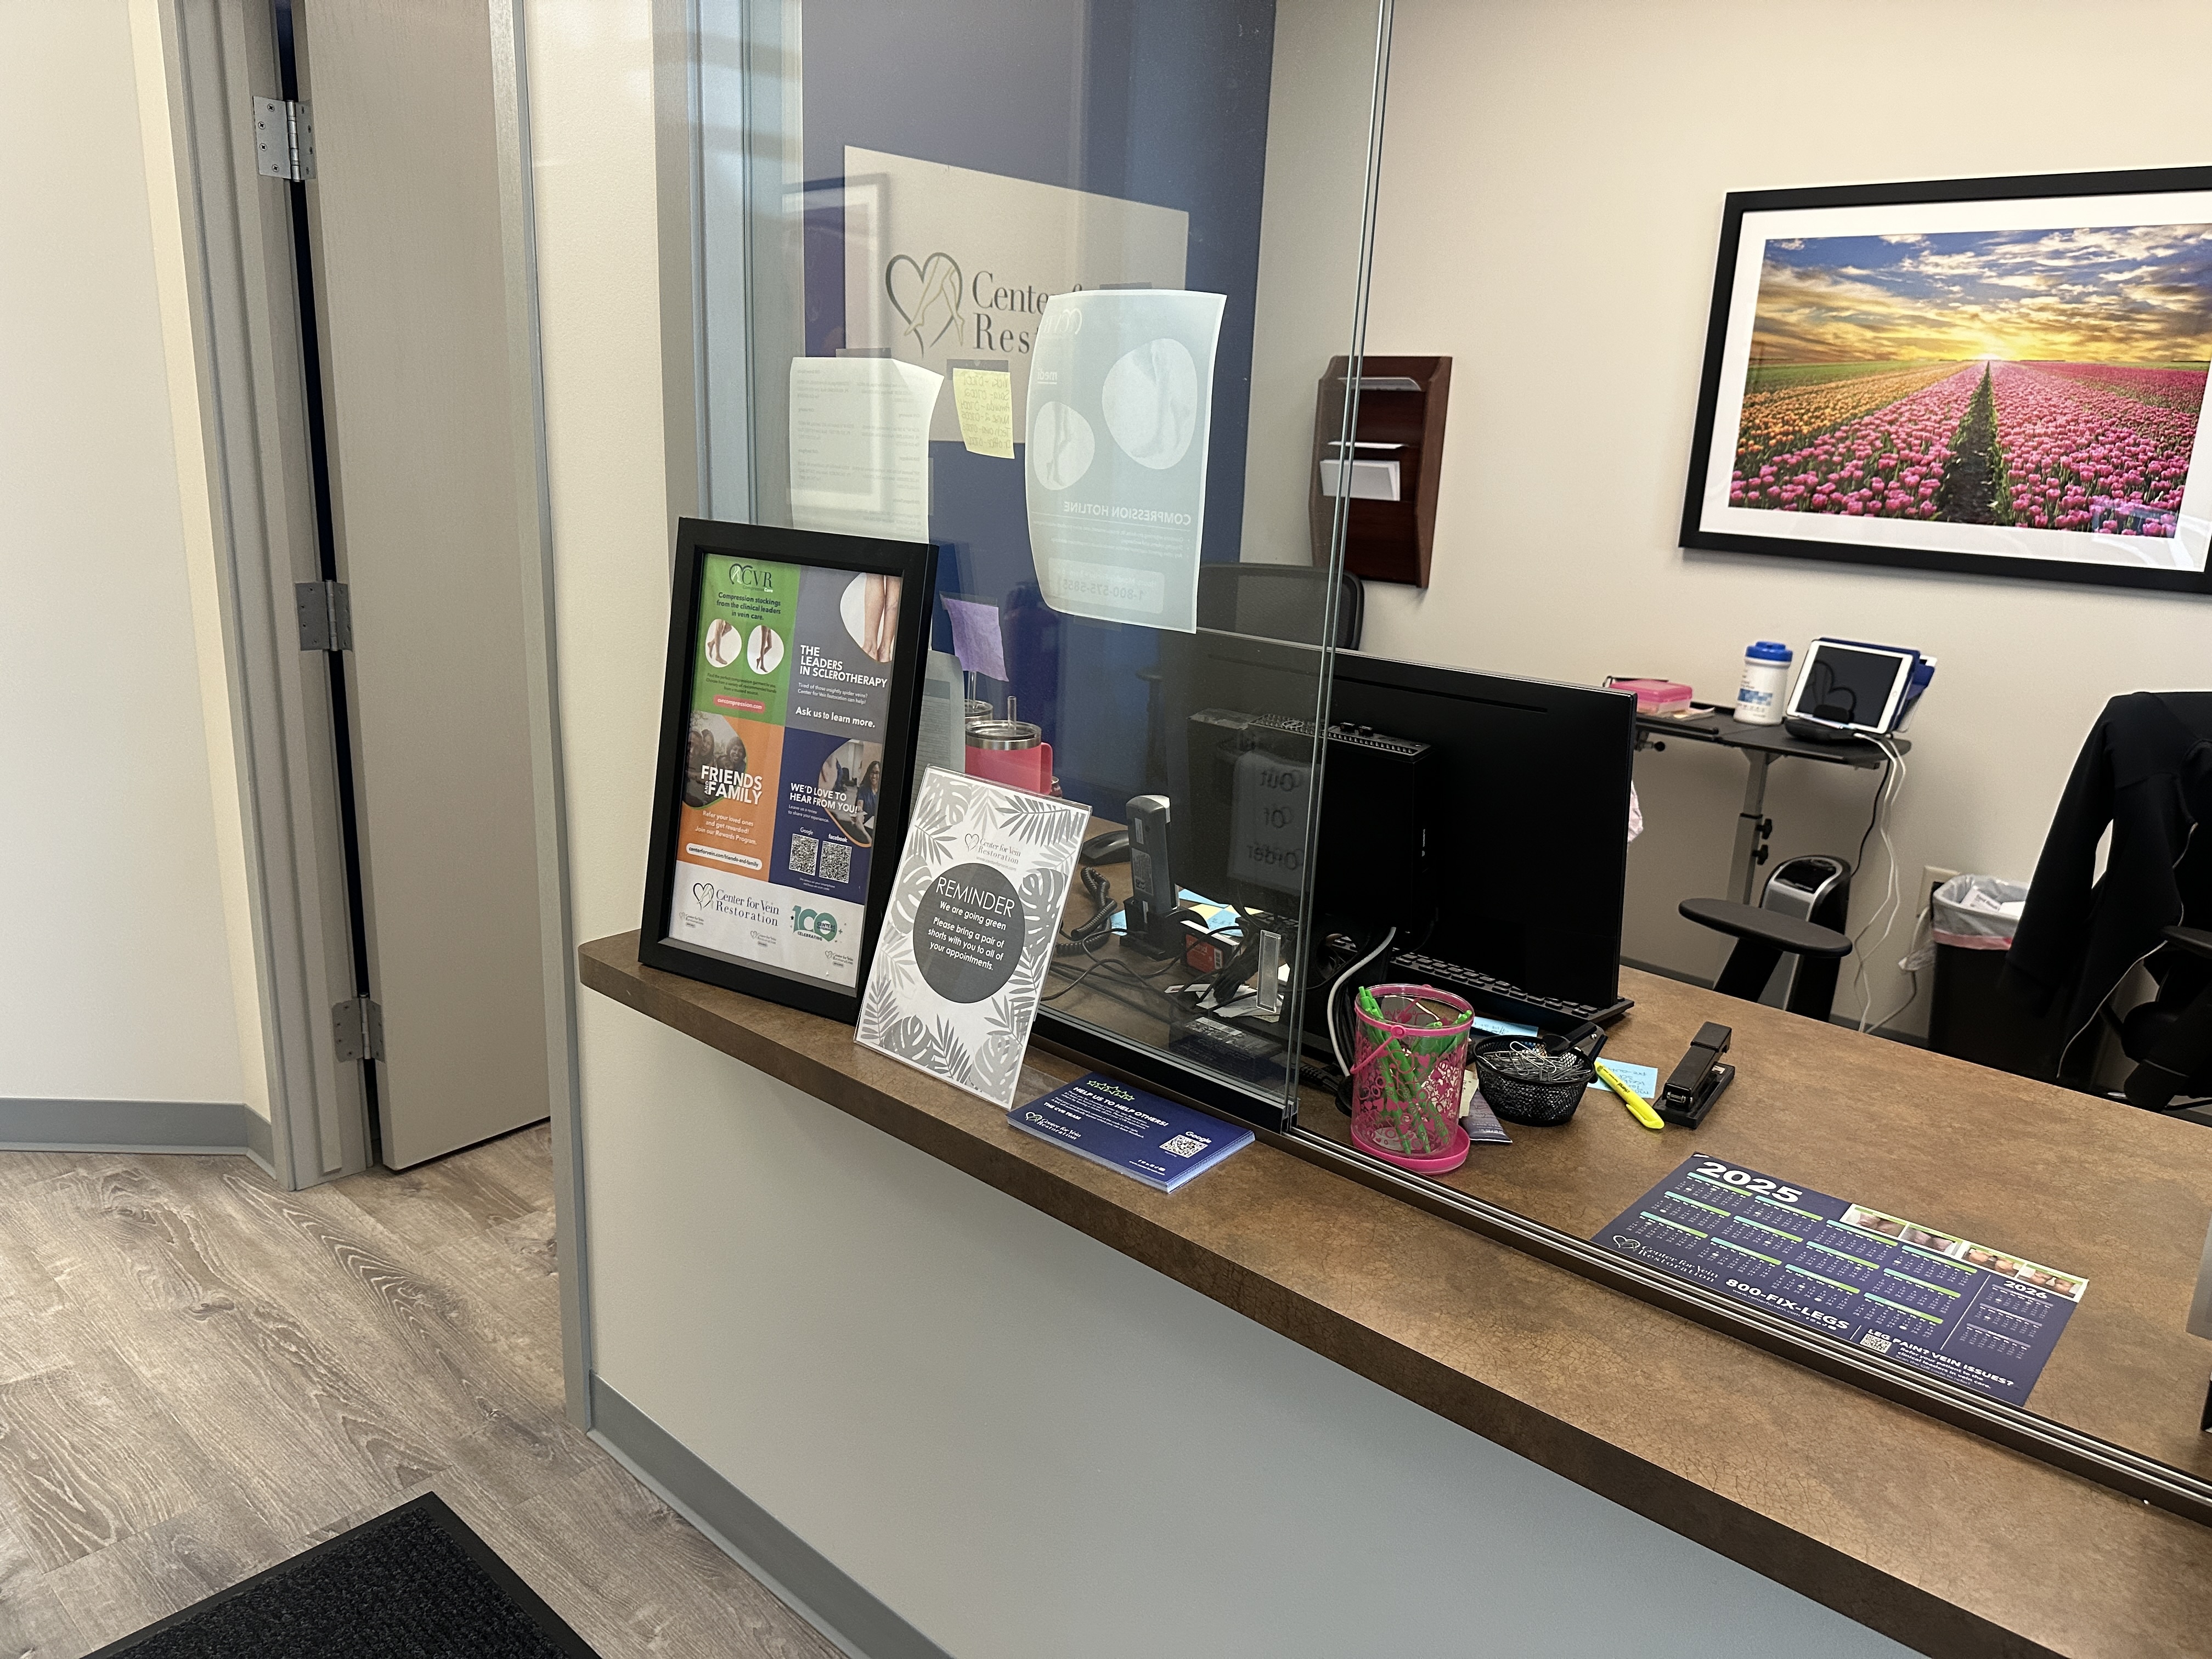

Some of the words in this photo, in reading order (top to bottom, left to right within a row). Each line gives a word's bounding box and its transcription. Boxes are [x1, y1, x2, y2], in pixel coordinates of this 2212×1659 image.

[972, 270, 1057, 315] Cente
[973, 313, 1039, 354] Res
[742, 569, 773, 588] CVR
[718, 592, 754, 602] Compression
[755, 597, 781, 607] stockings
[740, 602, 760, 612] clinical
[761, 606, 781, 614] leaders
[800, 645, 820, 657] THE
[800, 656, 843, 671] LEADERS
[799, 665, 810, 676] IN
[812, 668, 888, 688] SCLEROTHERAPY
[795, 706, 811, 716] Ask
[823, 711, 830, 720] to
[831, 712, 850, 724] learn
[852, 718, 876, 728] more.
[701, 765, 763, 791] FRIENDS
[708, 781, 763, 805] FAMILY
[789, 792, 811, 804] HEAR
[812, 797, 836, 810] FROM
[838, 802, 859, 814] YOU!
[791, 782, 812, 794] WE'D
[814, 787, 833, 799] LOVE
[835, 792, 847, 802] TO
[703, 810, 715, 819] Refer
[729, 815, 741, 825] loved
[725, 824, 749, 834] rewarded!
[715, 830, 735, 840] Rewards
[735, 836, 757, 845] Program.
[800, 827, 814, 836] Google
[828, 833, 848, 843] facebook
[978, 845, 1019, 865] Restoration
[980, 838, 999, 850] Center
[999, 844, 1008, 853] for
[1009, 846, 1021, 856] Vein
[716, 889, 745, 906] Center
[746, 896, 760, 910] for
[760, 900, 780, 915] Vein
[935, 876, 1015, 918] REMINDER
[715, 900, 779, 927] Restoration
[792, 905, 838, 942] 100
[940, 900, 950, 911] We
[951, 906, 963, 916] are
[964, 909, 985, 924] going
[985, 918, 1007, 930] green
[797, 930, 823, 941] CELEBRATING
[933, 916, 955, 931] Please
[956, 923, 973, 940] bring
[980, 934, 995, 945] pair
[996, 939, 1005, 949] of
[928, 928, 947, 941] shorts
[947, 934, 962, 946] with
[962, 940, 976, 951] you
[977, 945, 984, 954] to
[985, 947, 995, 957] all
[996, 952, 1004, 961] of
[929, 941, 945, 952] your
[945, 946, 994, 971] appointments.
[1065, 1111, 1082, 1120] TEAM
[1073, 1086, 1093, 1096] HELP
[1114, 1104, 1136, 1113] HELP
[1134, 1111, 1169, 1127] OTHERS!
[1037, 1120, 1077, 1140] Restoration
[1041, 1118, 1060, 1128] Center
[1185, 1131, 1212, 1144] Google
[1696, 1161, 1803, 1204] 2025
[1638, 1249, 1714, 1282] Restoration
[1642, 1246, 1678, 1261] Center
[1679, 1260, 1695, 1268] for
[1697, 1265, 1718, 1278] Vein
[2003, 1280, 2047, 1299] 2026
[1725, 1279, 1850, 1330] 800-FIX-LEGS
[1732, 1289, 1801, 1317] www.centerforvein.com
[1867, 1328, 1891, 1340] LEG
[1892, 1338, 1930, 1355] PAIN?
[1931, 1352, 1961, 1369] VEIN
[1963, 1364, 2014, 1387] ISSUES?
[1897, 1351, 1922, 1362] clinical
[1922, 1360, 1948, 1372] leaders
[1957, 1374, 1973, 1382] vein
[1900, 1347, 1919, 1357] Refer
[1919, 1355, 1936, 1363] your
[1936, 1361, 1961, 1373] patient
